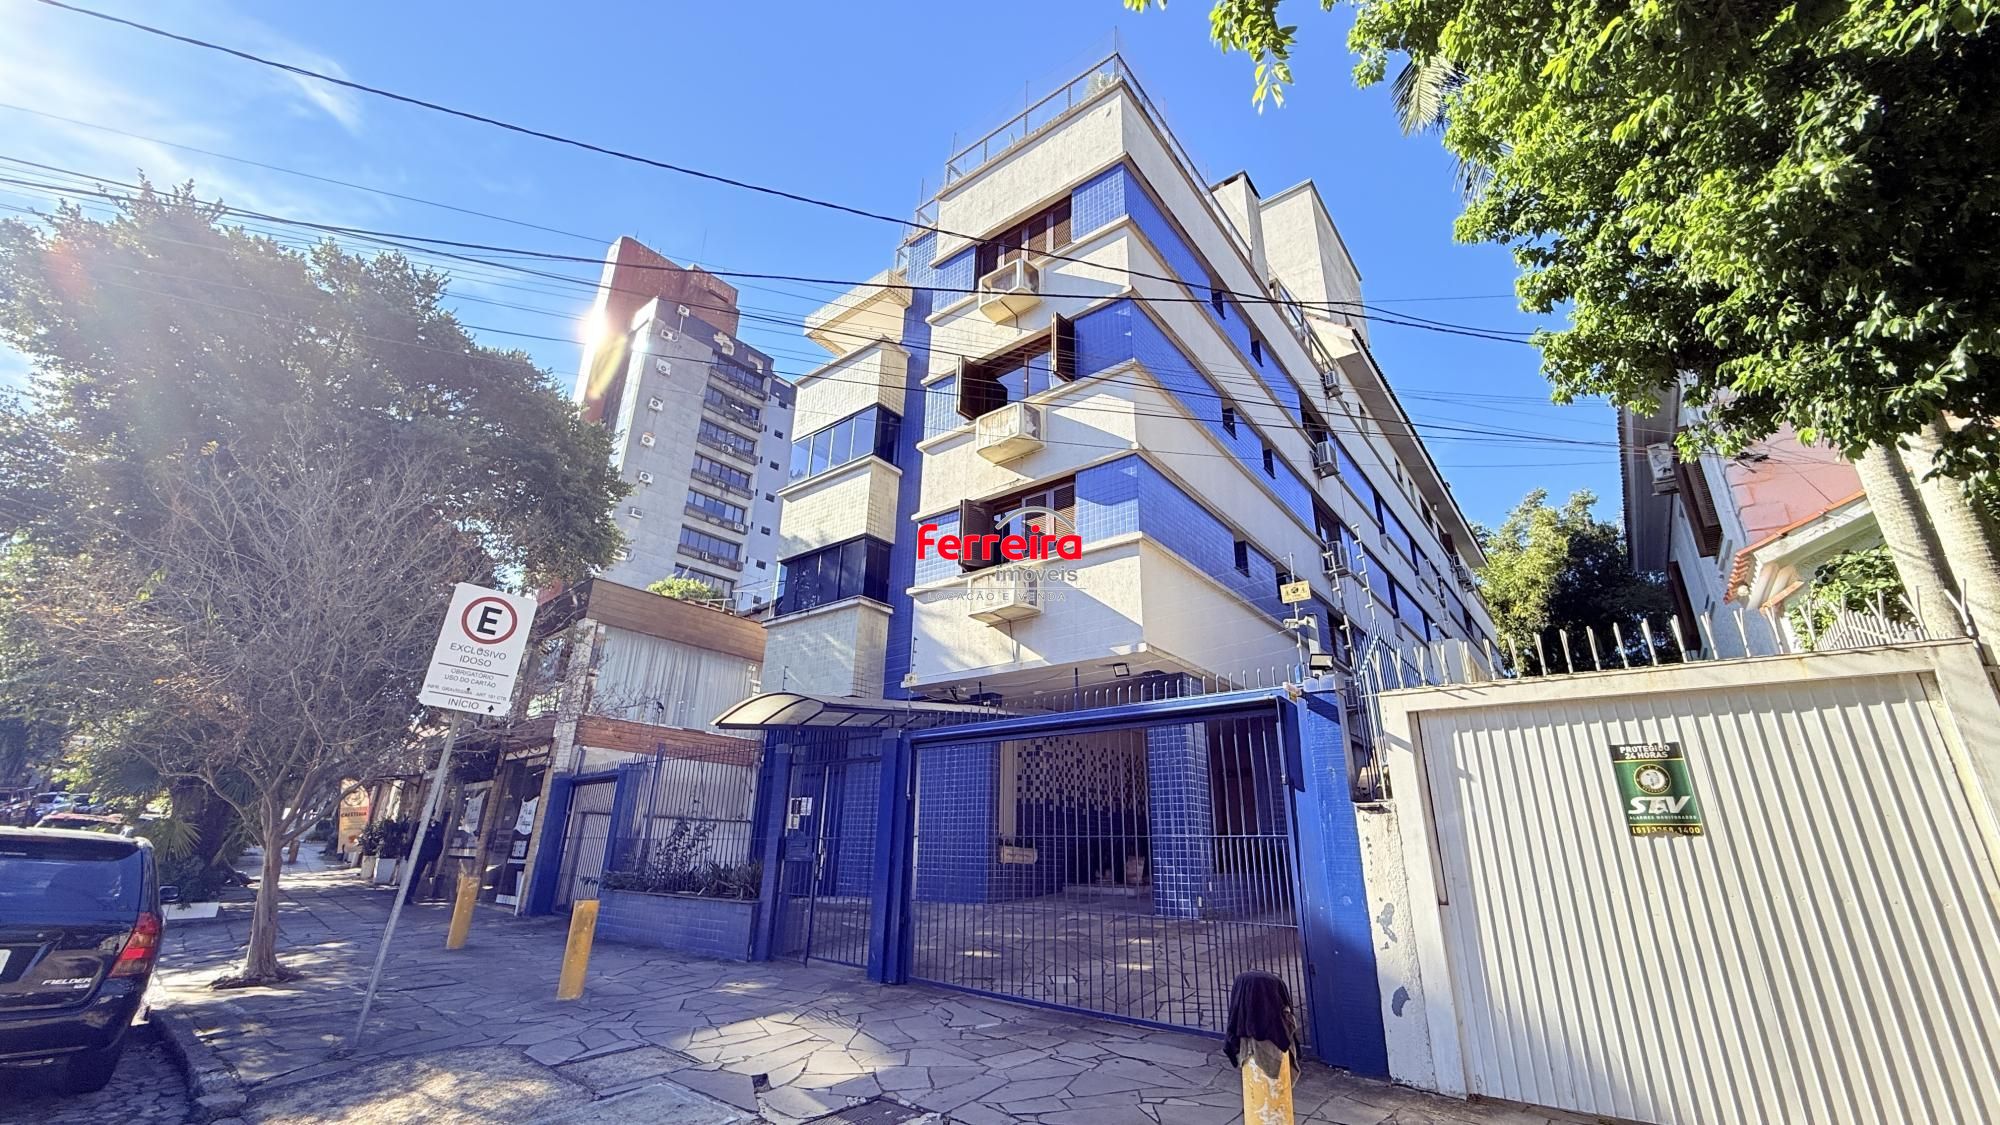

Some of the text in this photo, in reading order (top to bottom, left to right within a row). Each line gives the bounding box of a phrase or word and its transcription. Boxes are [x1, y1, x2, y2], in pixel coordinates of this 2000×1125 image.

[476, 605, 503, 636] E
[449, 642, 507, 661] EXCLUSIVO
[459, 654, 492, 668] IDOSO
[444, 674, 459, 682] USO
[447, 697, 480, 710] INÍCIO
[1620, 745, 1670, 754] PROTEGIDO
[1624, 751, 1669, 760] 24 HORAS
